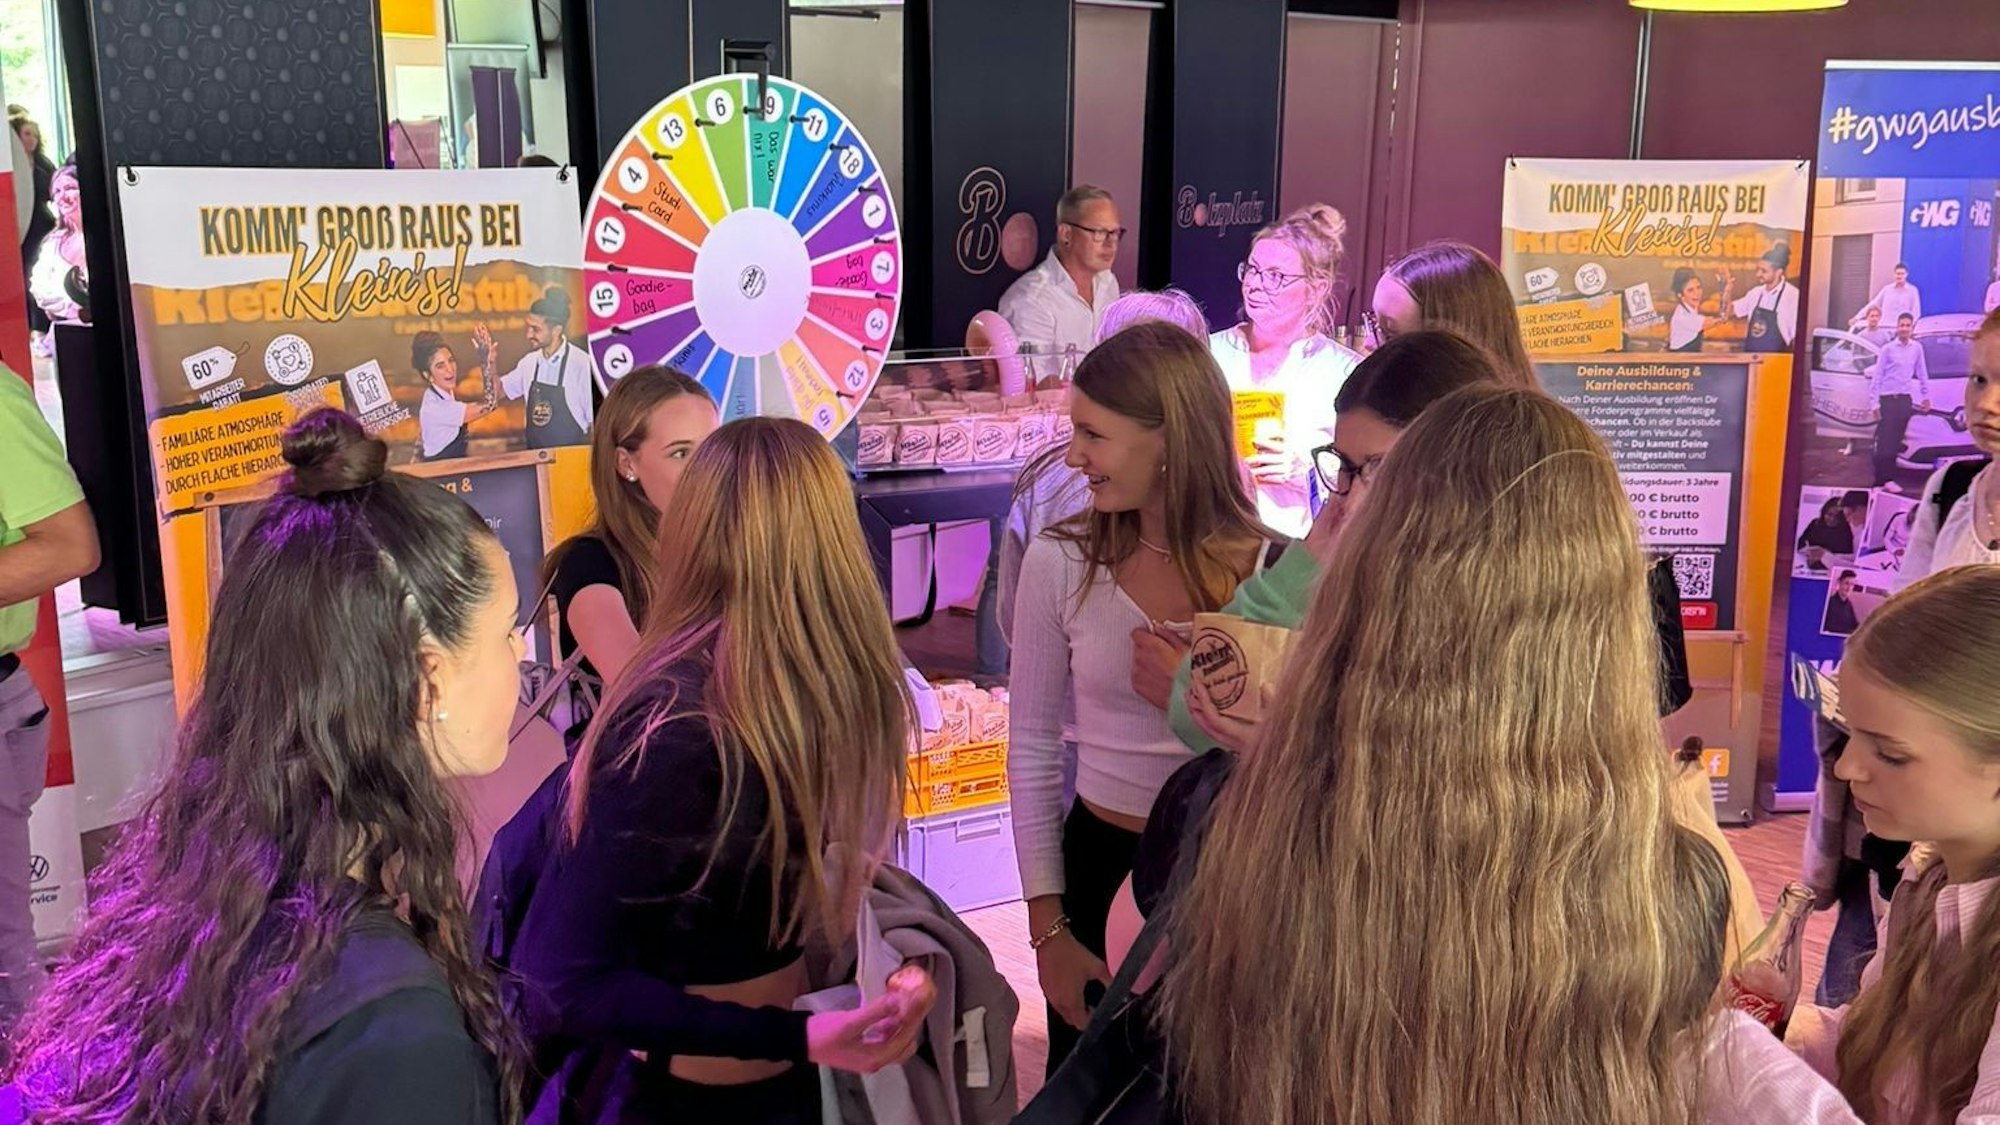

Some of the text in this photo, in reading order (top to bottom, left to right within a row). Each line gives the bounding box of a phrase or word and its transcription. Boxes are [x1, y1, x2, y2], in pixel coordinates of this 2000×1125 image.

[715, 97, 726, 117] 6
[766, 96, 776, 115] 9
[663, 118, 683, 143] 13
[807, 114, 823, 136] 11
[767, 131, 780, 183] Das war
[843, 151, 860, 175] 18
[627, 166, 643, 184] 4
[653, 181, 682, 211] Studi
[1549, 184, 1617, 214] KOMM'
[1677, 183, 1730, 214] RAUS
[1735, 185, 1766, 214] BEI
[648, 202, 673, 224] Card
[869, 204, 881, 218] 1
[200, 203, 522, 255] KOMM' GROß RAUS BEI
[602, 222, 621, 246] 17
[1591, 203, 1725, 258] Klein's!
[876, 261, 890, 273] 7
[283, 235, 469, 323] Klein's!
[625, 279, 673, 296] Goodie-
[596, 288, 614, 311] 15
[632, 299, 657, 315] bag
[870, 318, 884, 331] 3
[191, 358, 219, 380] 60%
[610, 352, 627, 369] 2
[847, 366, 865, 387] 12
[1577, 366, 1702, 380] Deine Ausbildung &
[1585, 379, 1694, 391] Karrierechancen:
[1583, 395, 1613, 404] Deiner
[1614, 395, 1663, 406] Ausbildung
[1705, 395, 1719, 404] Dir
[818, 409, 830, 427] 5
[1591, 406, 1672, 417] Förderprogramme
[1633, 417, 1647, 426] Ob
[1659, 417, 1674, 426] der
[1676, 417, 1721, 426] Backstube
[1618, 428, 1638, 437] oder
[1640, 429, 1652, 437] im
[1654, 428, 1688, 437] Verkauf
[1631, 440, 1644, 448] Du
[1646, 440, 1679, 448] kannst
[1681, 440, 1709, 448] Deine
[166, 452, 200, 473] HOHER
[202, 433, 283, 463] VERANTWORTUN
[1612, 450, 1706, 461] tiv mitgestalten und
[166, 472, 200, 495] DURCH
[201, 463, 241, 485] FLACHE
[461, 477, 473, 493] &
[1686, 478, 1692, 486] 3
[1693, 478, 1719, 486] Jahre
[1629, 493, 1646, 502] 00
[1660, 493, 1700, 502] brutto
[1661, 510, 1699, 519] brutto
[1659, 526, 1698, 535] brutto
[31, 893, 58, 904] rvice
